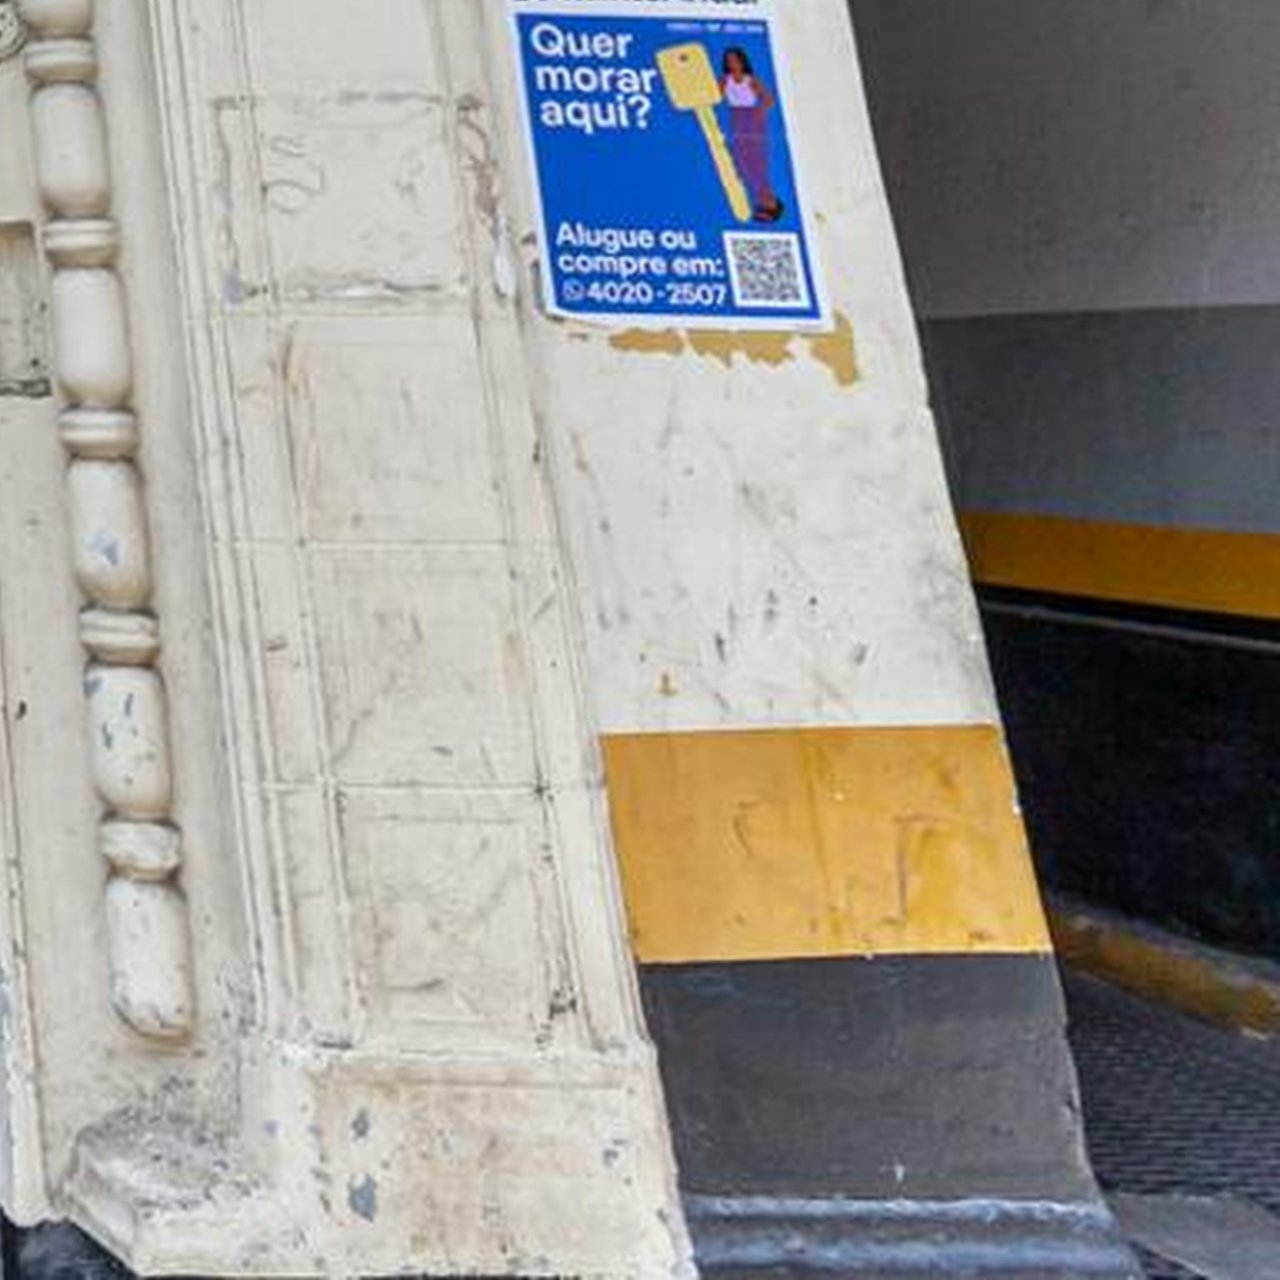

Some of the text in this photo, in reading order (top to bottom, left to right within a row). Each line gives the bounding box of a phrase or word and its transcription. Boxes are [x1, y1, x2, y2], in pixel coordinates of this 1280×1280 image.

[531, 23, 633, 59] Quer
[535, 64, 658, 95] morar
[539, 94, 653, 135] aqui?
[556, 222, 696, 253] Alugue ou
[557, 253, 725, 278] compre em:
